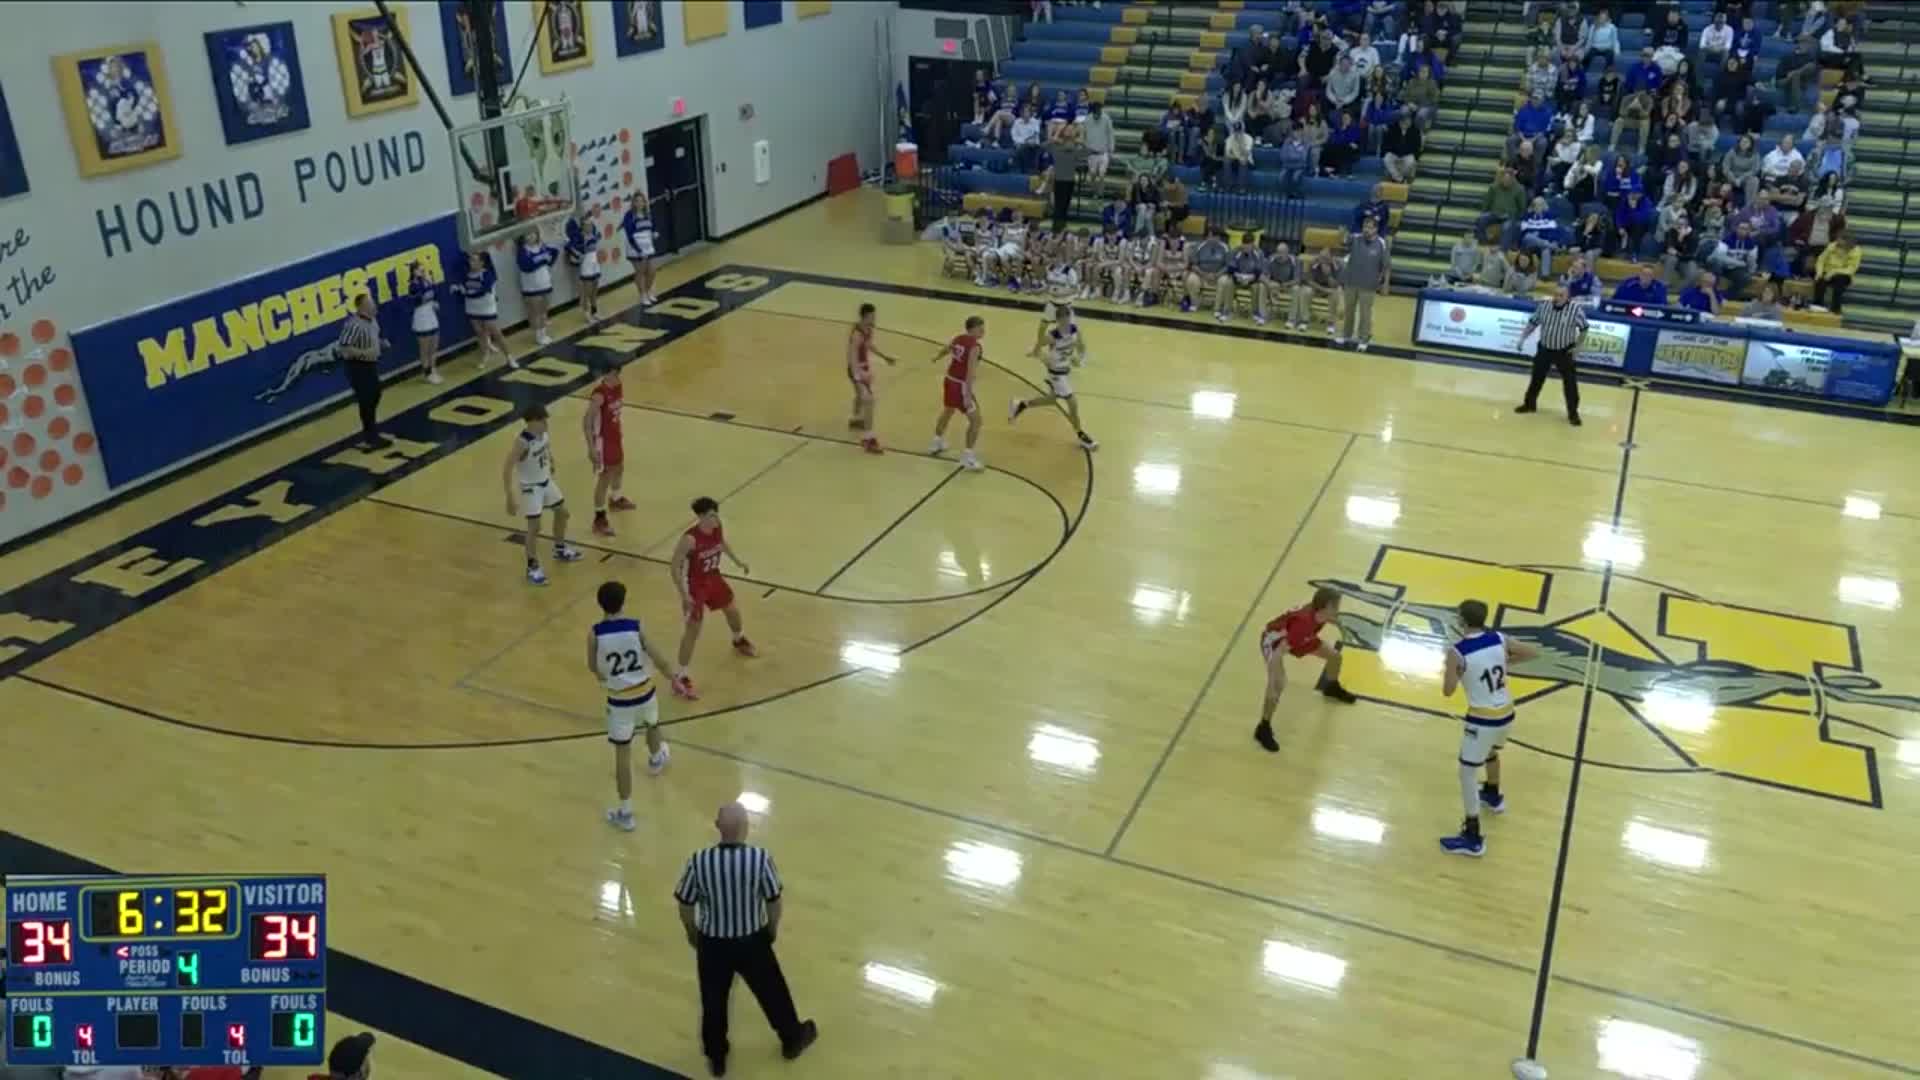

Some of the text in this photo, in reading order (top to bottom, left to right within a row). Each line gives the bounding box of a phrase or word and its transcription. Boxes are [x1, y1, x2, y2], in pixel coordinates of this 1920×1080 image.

[96, 130, 426, 259] HOUND POUND
[6, 265, 57, 306] the
[606, 649, 643, 677] 22
[1479, 664, 1505, 694] 12
